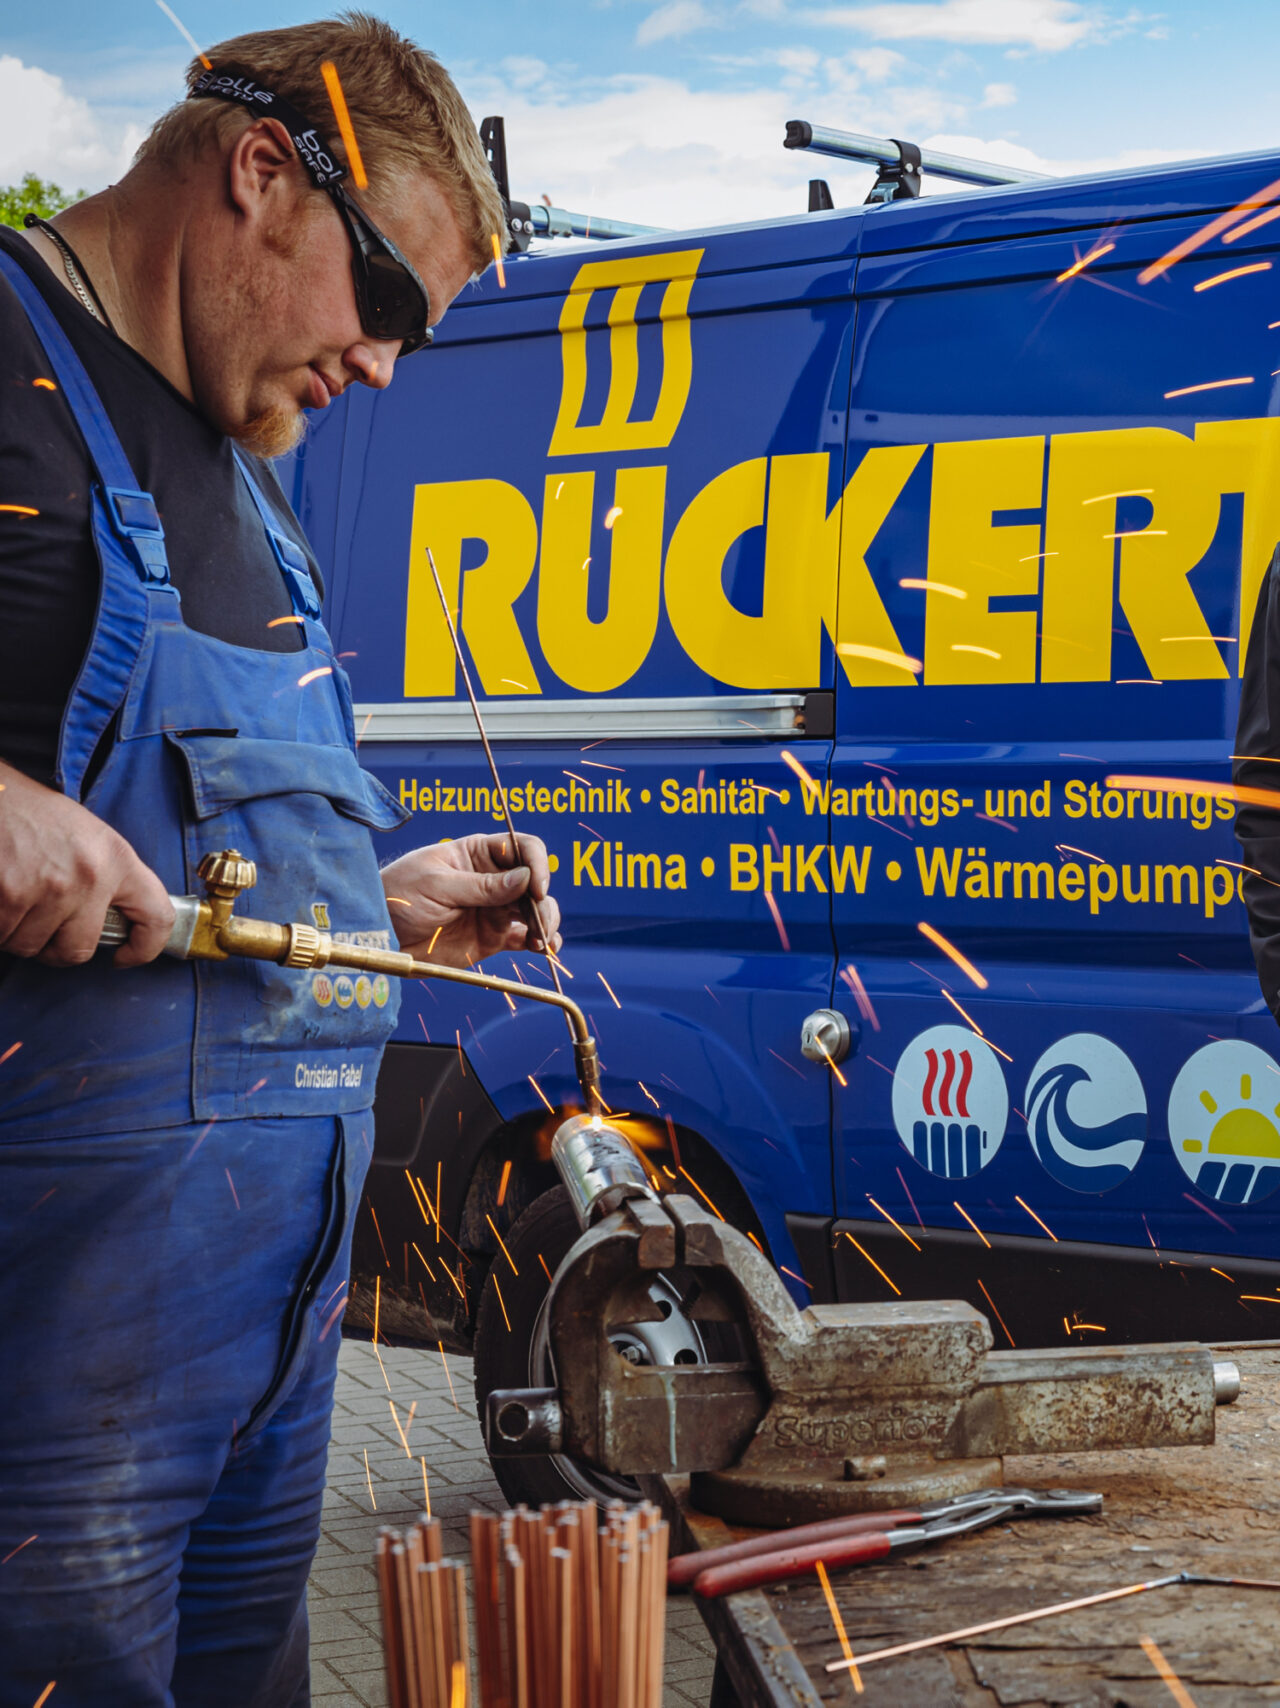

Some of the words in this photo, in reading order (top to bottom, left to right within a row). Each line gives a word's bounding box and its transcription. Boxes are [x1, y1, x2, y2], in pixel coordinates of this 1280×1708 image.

[399, 778, 631, 820] Heizungstechnik
[660, 778, 770, 814] Sanitär
[800, 779, 973, 827] Wartungs-
[985, 780, 1051, 818] und
[1063, 778, 1236, 830] Störungs
[572, 841, 687, 890] Klima
[730, 843, 872, 894] BHKW
[915, 846, 1246, 919] Wärmepump
[295, 1063, 338, 1088] Christian
[775, 1405, 947, 1450] Superior
